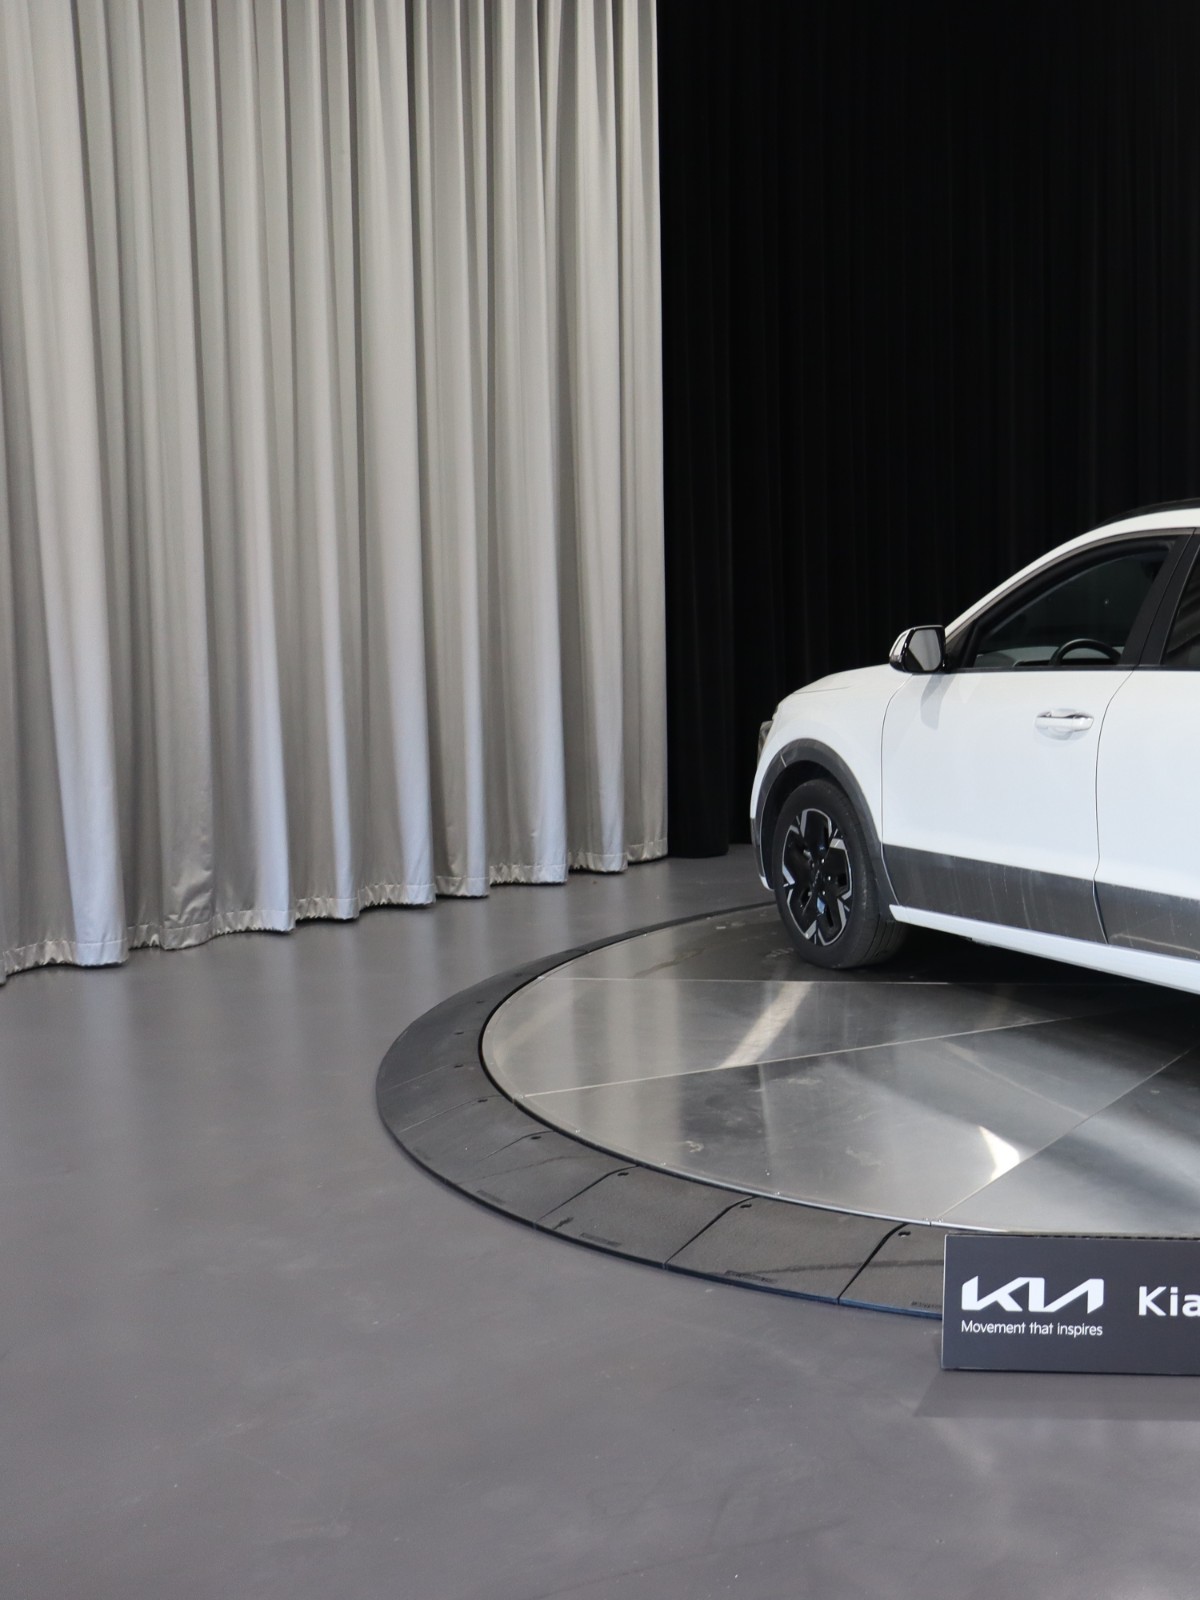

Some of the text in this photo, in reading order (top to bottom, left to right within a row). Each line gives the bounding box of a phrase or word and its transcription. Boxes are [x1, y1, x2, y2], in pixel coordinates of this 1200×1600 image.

[961, 1275, 1105, 1314] KIA
[960, 1319, 1103, 1338] Movement that inspires
